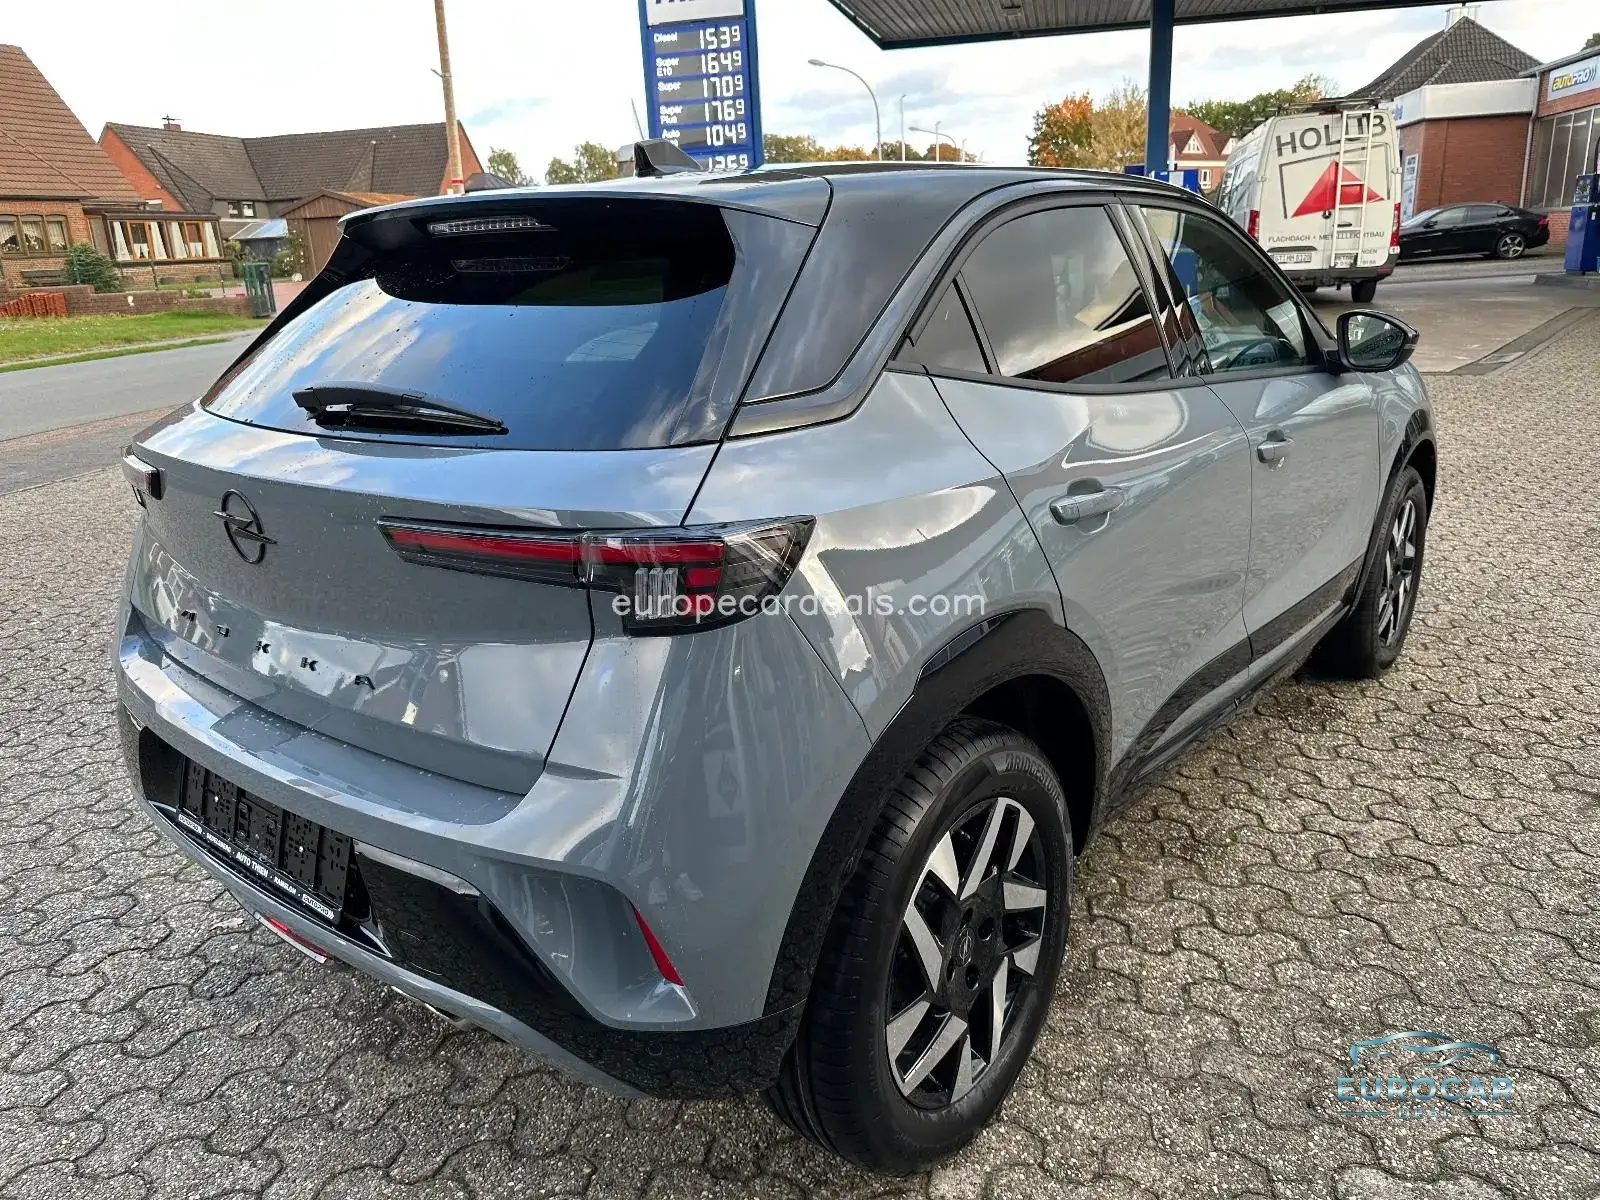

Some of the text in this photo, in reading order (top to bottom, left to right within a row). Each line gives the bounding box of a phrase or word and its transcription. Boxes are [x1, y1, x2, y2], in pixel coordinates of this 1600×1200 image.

[656, 57, 680, 67] Super
[656, 67, 673, 77] E10
[658, 81, 681, 92] Super
[659, 105, 683, 116] Super
[1275, 114, 1387, 157] HOLUB
